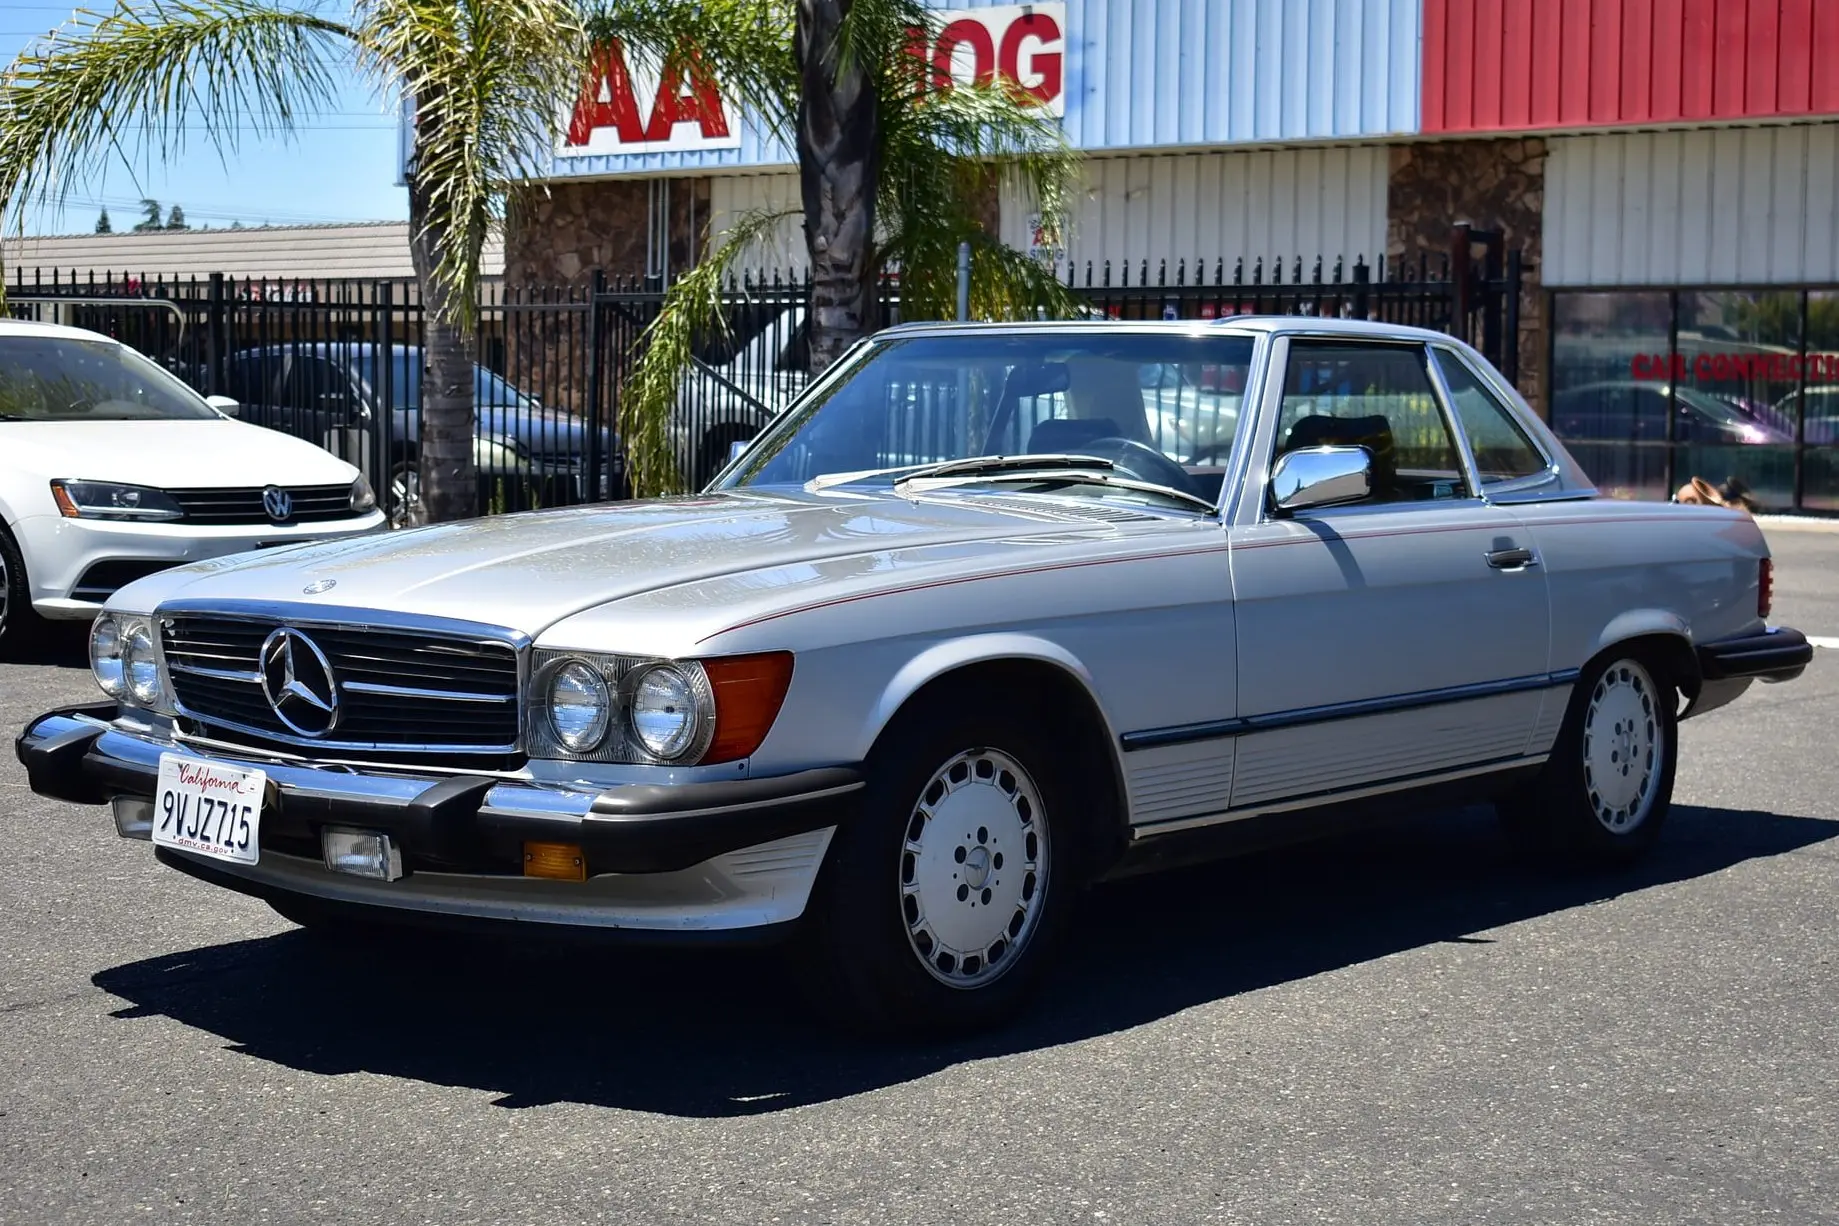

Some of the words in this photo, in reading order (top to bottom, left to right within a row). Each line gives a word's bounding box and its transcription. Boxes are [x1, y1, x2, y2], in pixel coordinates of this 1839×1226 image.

[1030, 247, 1064, 260] SMG
[1631, 353, 1686, 381] CAR
[1694, 352, 1839, 382] CONNECTI
[180, 763, 245, 795] California
[160, 790, 252, 850] 9VJZ715
[178, 837, 229, 854] dmv.ca.gov
